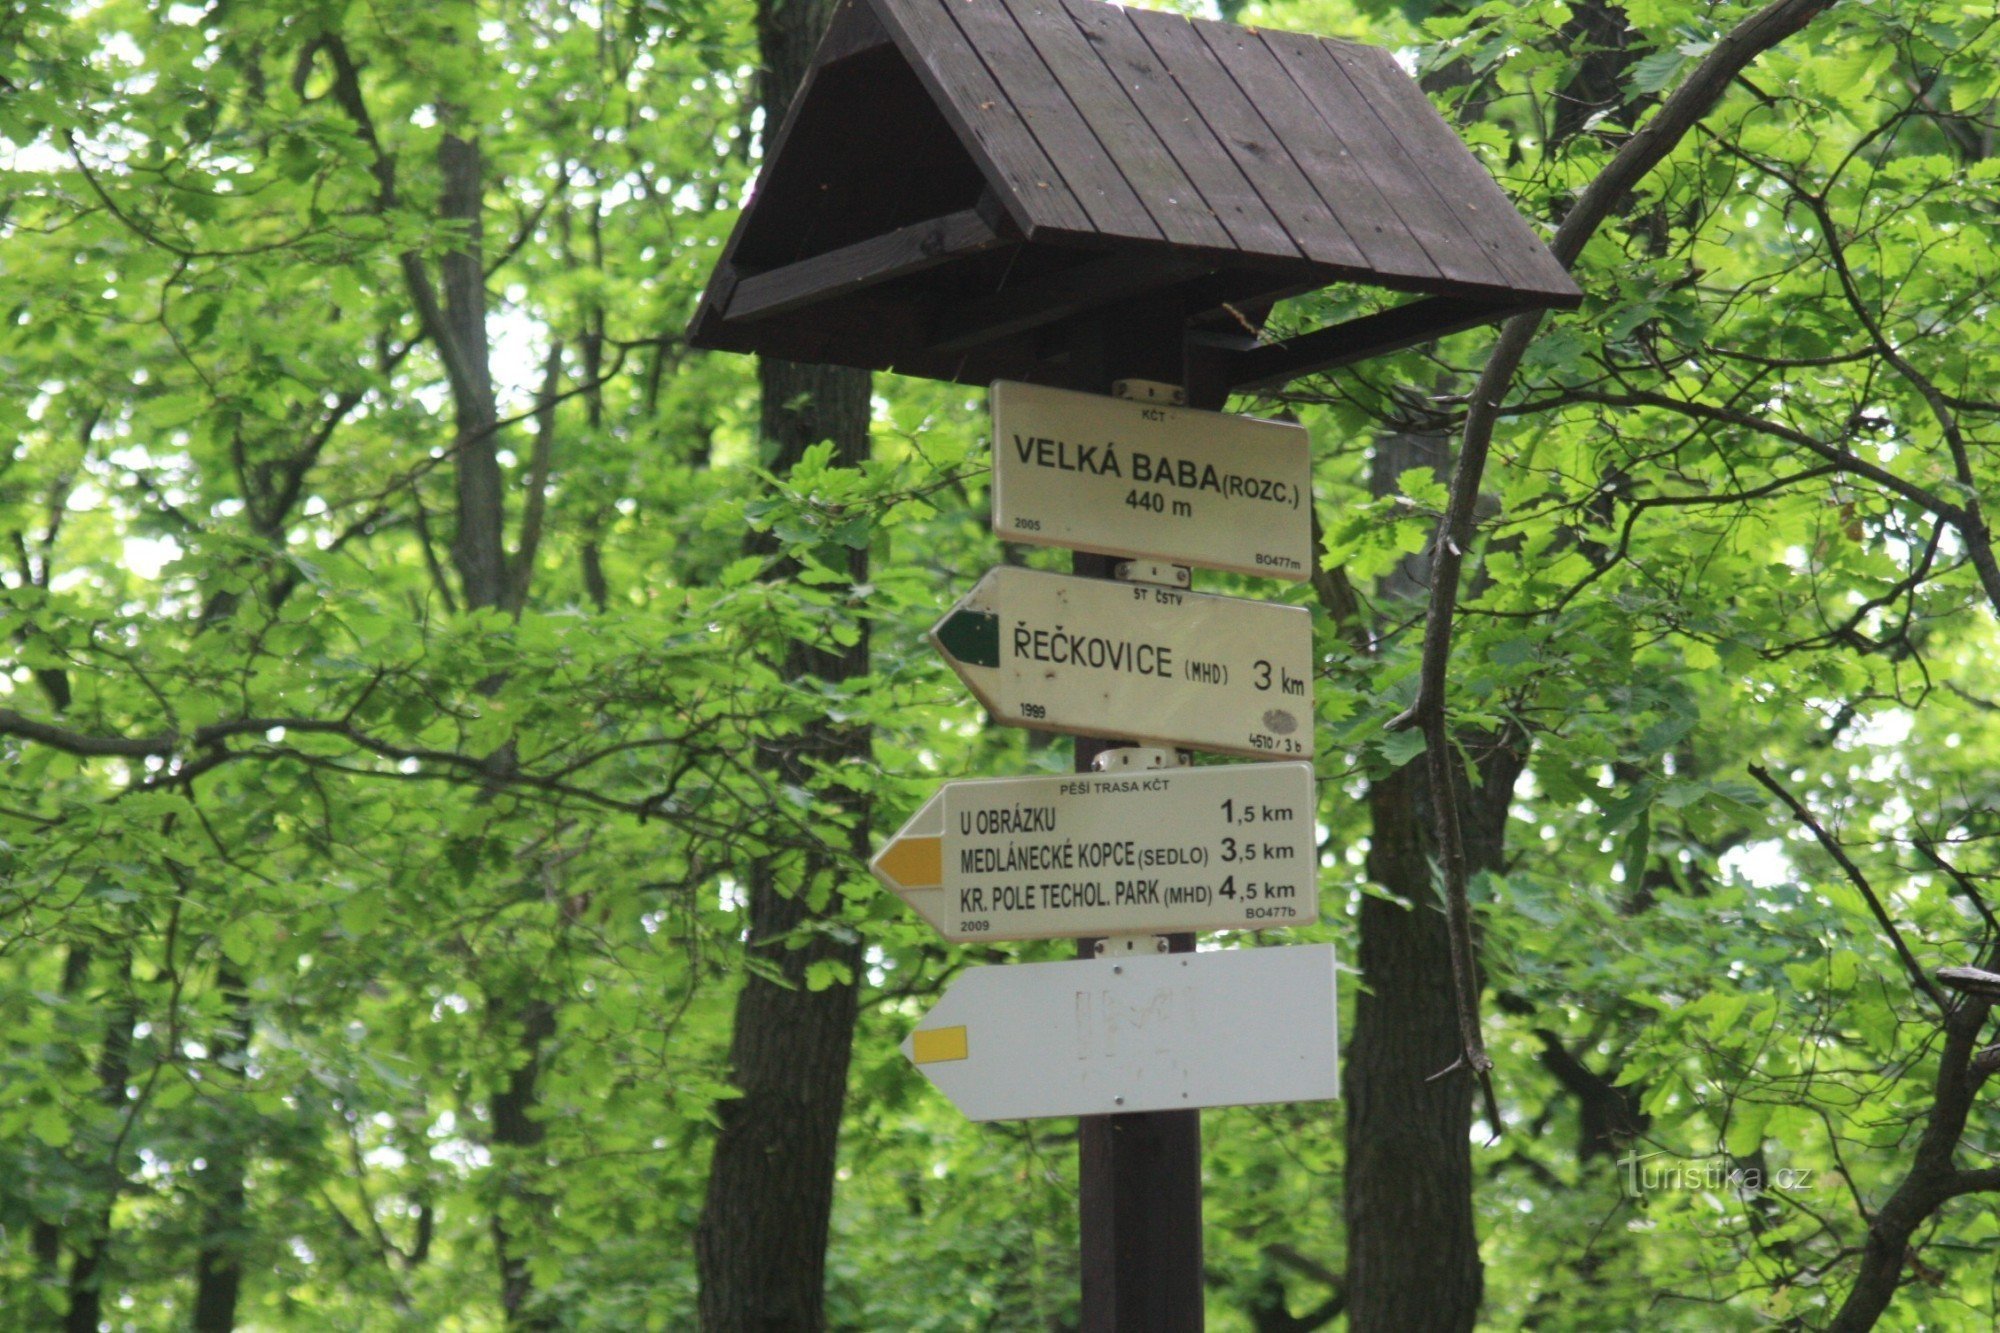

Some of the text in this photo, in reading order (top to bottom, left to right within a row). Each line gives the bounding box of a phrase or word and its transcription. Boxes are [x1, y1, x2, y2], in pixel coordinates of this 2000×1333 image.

[1142, 408, 1165, 422] KČT
[1013, 434, 1299, 510] VELKÁ BABA (ROZC.)
[1125, 489, 1192, 517] 440 m
[1015, 517, 1041, 531] 2005
[1134, 588, 1148, 601] ST
[1014, 621, 1305, 696] ŘEČKOVICE (MHD) 3 km
[1020, 702, 1046, 719] 1999
[1060, 778, 1170, 796] PĚŠÍ TRASA KČT
[960, 798, 1293, 835] U OBRÁZKU 1,5 km
[960, 837, 1295, 874] MEDLÁNECKÉ KOPCE (SEDLO) 3,5 km
[960, 875, 1296, 912] KR. POLE TECHOL. PARK (MHD) 4,5 km
[960, 920, 990, 933] 2009
